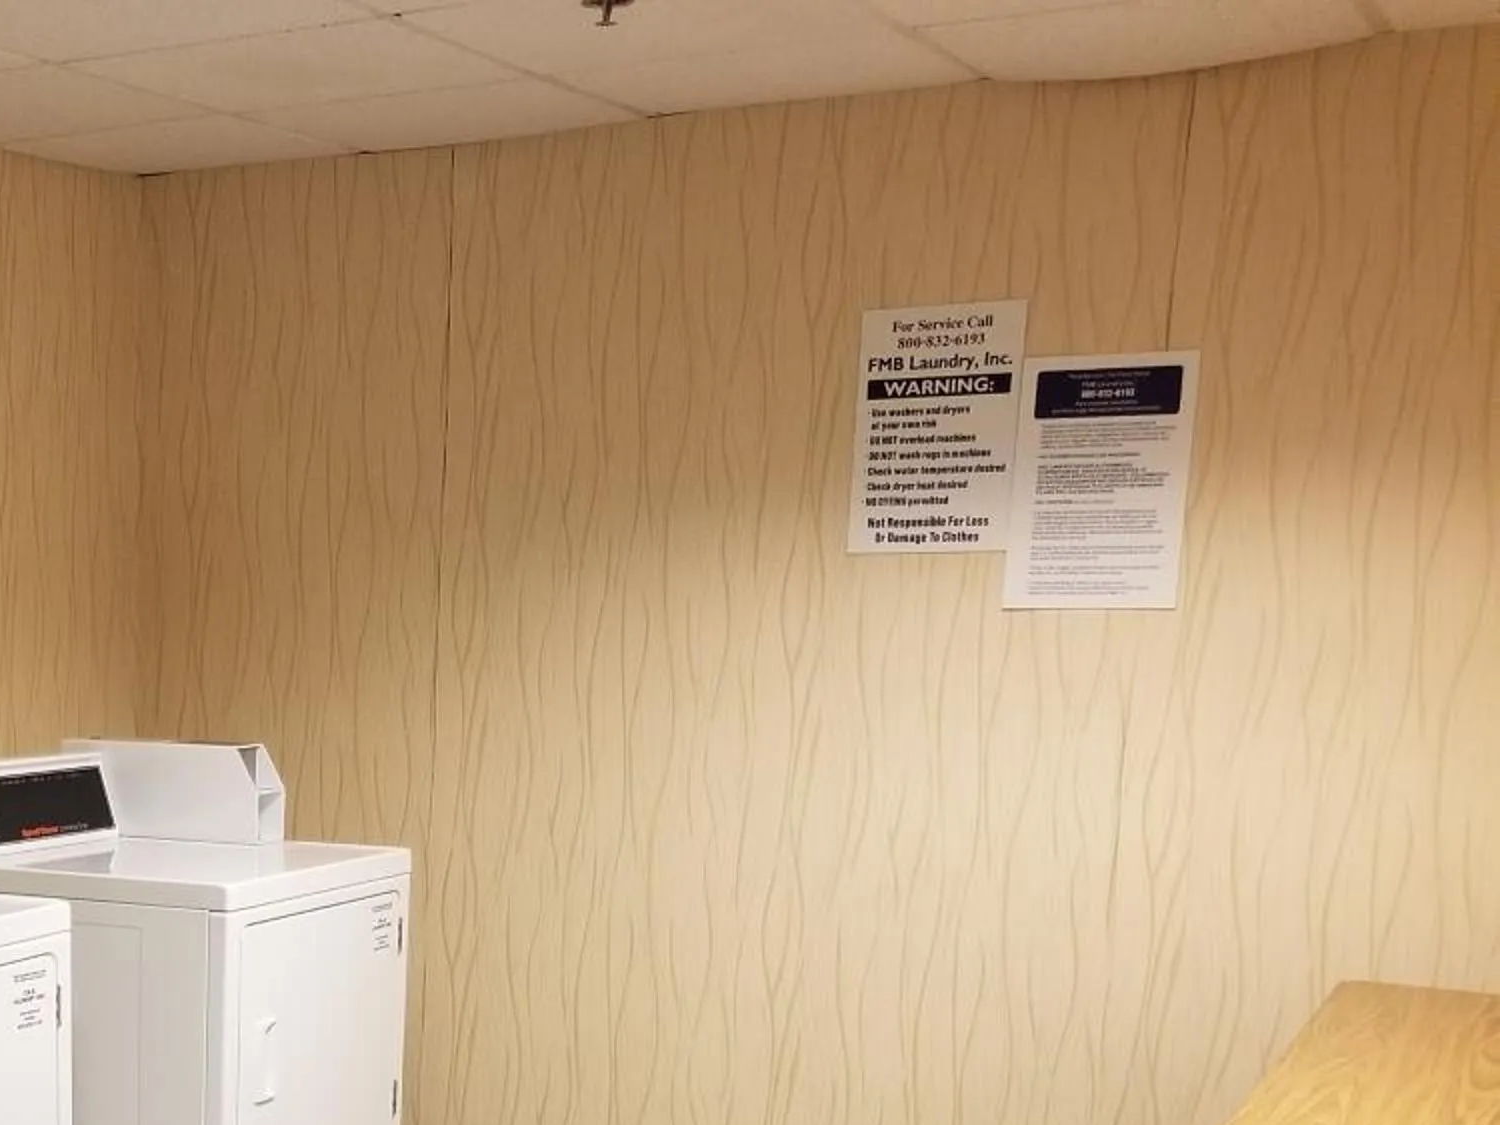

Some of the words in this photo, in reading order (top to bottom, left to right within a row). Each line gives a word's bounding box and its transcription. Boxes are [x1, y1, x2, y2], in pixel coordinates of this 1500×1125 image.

[892, 321, 914, 333] For
[918, 317, 964, 331] Service
[967, 314, 993, 329] Call
[897, 332, 985, 349] 800-832-6193
[868, 357, 904, 372] FMB
[910, 353, 979, 371] Laundry,
[984, 351, 1013, 366] Inc.
[883, 377, 995, 397] WARNING:
[888, 407, 924, 417] washers
[926, 405, 941, 414] and
[942, 405, 971, 416] dryers
[900, 434, 935, 444] overload
[936, 434, 976, 443] machines
[899, 450, 921, 460] wash
[868, 467, 892, 476] Check
[920, 465, 973, 475] temperature
[868, 482, 891, 491] Check
[893, 481, 915, 492] dryer
[937, 480, 968, 489] desired
[868, 517, 885, 528] Not
[888, 516, 946, 529] Responsible
[948, 516, 963, 526] For
[966, 516, 989, 527] Loss
[875, 532, 885, 543] Or
[887, 532, 927, 544] Damage
[930, 531, 940, 542] To
[942, 531, 979, 543] Clothes
